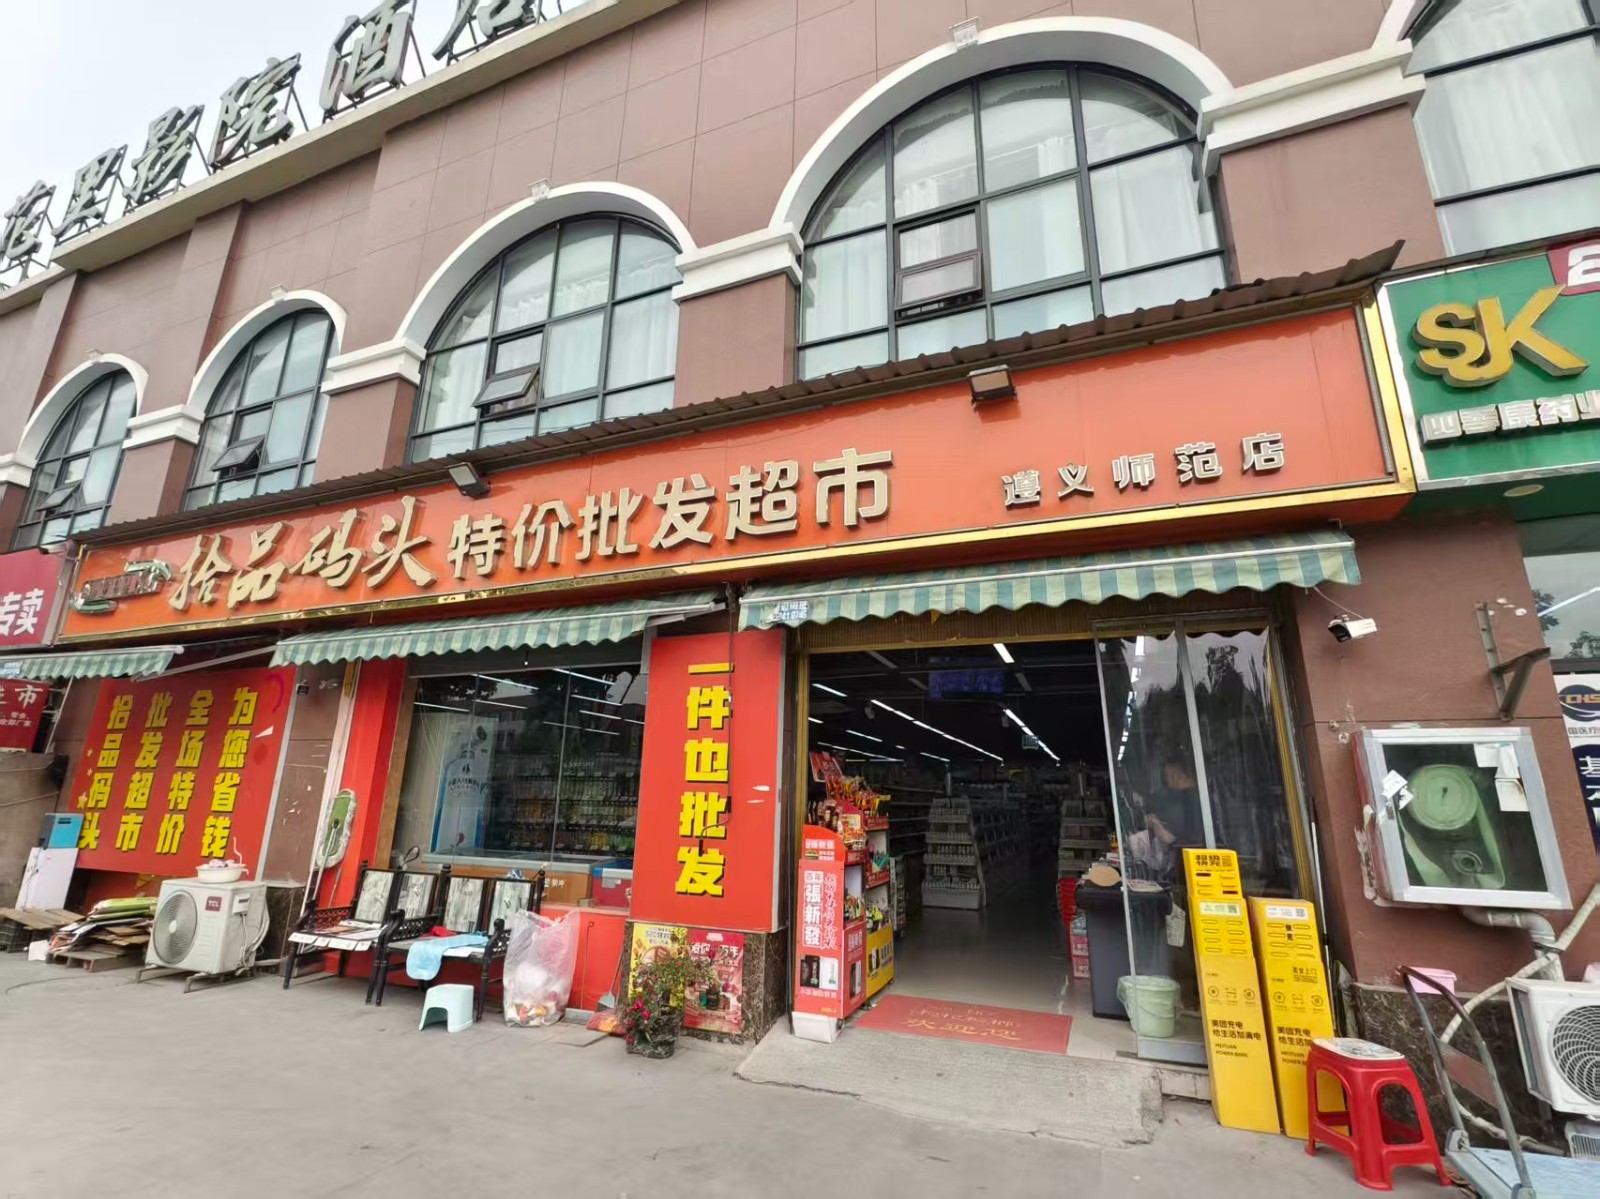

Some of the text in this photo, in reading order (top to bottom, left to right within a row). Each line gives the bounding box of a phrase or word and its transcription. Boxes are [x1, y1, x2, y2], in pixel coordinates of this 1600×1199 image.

[1001, 432, 1285, 509] 遵义师范店
[78, 695, 134, 850] 拾品码头
[115, 691, 173, 852] 批发超市
[155, 689, 215, 855] 全场特价
[201, 687, 259, 858] 为您省钱
[675, 662, 735, 897] 一件也批发
[208, 900, 220, 908] TCL
[1211, 1019, 1244, 1030] 美团充电
[1212, 1029, 1262, 1041] 给生活加满电
[1276, 1026, 1312, 1037] 美团充电
